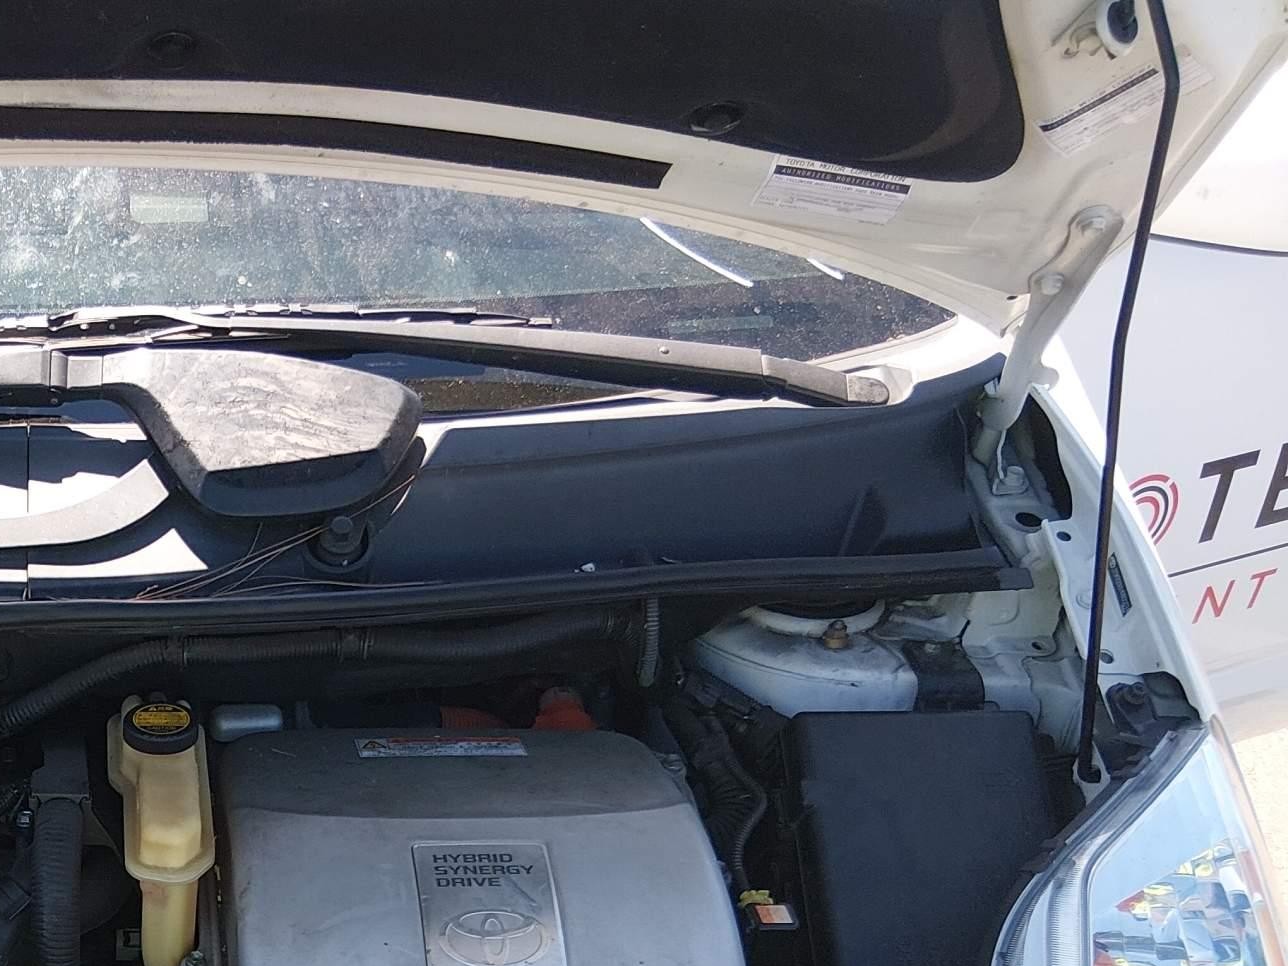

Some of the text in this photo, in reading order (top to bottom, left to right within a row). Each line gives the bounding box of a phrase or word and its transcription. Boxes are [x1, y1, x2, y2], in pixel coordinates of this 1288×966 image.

[785, 158, 816, 168] TOYOTA
[818, 161, 847, 173] MOTOR
[781, 167, 832, 180] AUTHORIZED
[432, 853, 513, 863] HYBRID
[434, 865, 534, 876] SYNERGY
[436, 877, 502, 888] DRIVE
